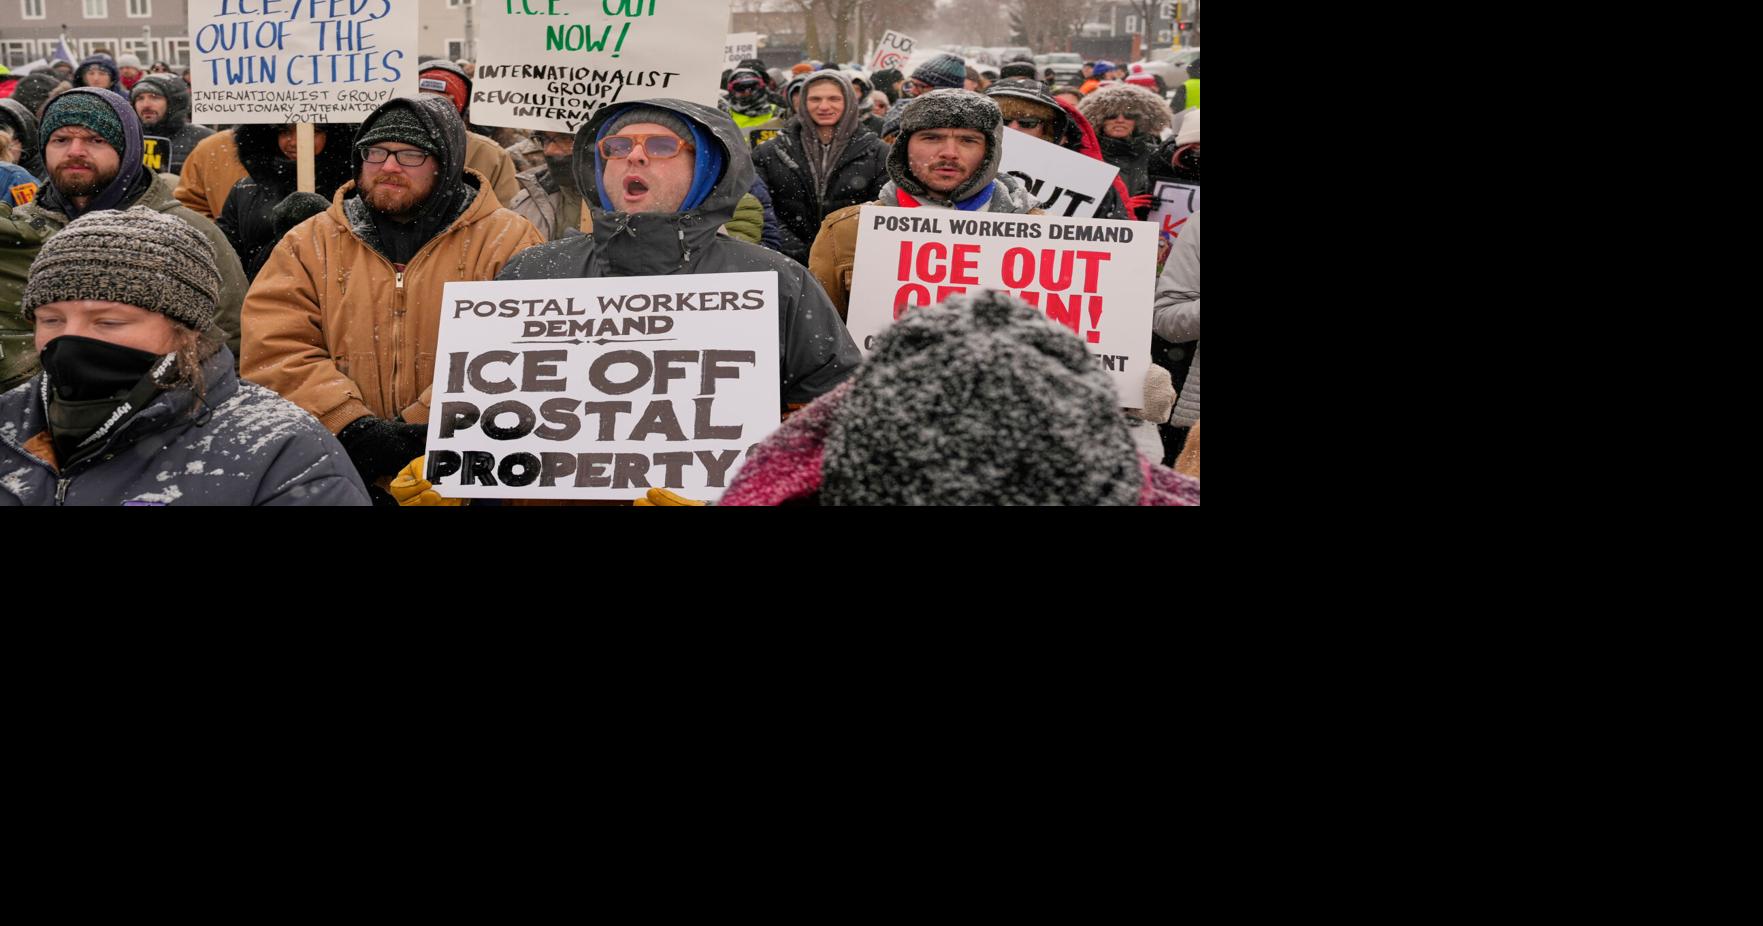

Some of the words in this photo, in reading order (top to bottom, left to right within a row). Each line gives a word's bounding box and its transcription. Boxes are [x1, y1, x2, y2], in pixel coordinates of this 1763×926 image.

[310, 19, 377, 51] THE
[546, 22, 631, 58] NOW!
[202, 55, 277, 86] TWIN
[287, 49, 404, 86] CITIES
[478, 64, 681, 88] INTERNATIONALIST
[193, 90, 330, 102] INTERNATIONALIST
[337, 87, 395, 102] GROUP/
[473, 90, 607, 110] REVOLUTION
[547, 81, 624, 103] GROUP/
[193, 103, 295, 113] REVOLUTIONARY
[300, 102, 381, 112] INTERNATIO
[284, 113, 329, 124] YOUTH
[873, 215, 942, 234] POSTAL
[949, 219, 1042, 239] WORKERS
[1049, 224, 1134, 243] DEMAND
[897, 240, 981, 285] ICE
[1001, 246, 1111, 294] OUT
[452, 297, 585, 319] POSTAL
[596, 289, 765, 314] WORKERS
[1002, 290, 1103, 344] N!
[521, 315, 674, 338] DEMAND
[444, 349, 568, 394] ICE
[588, 349, 756, 395] OFF
[438, 397, 744, 441] POSTAL
[427, 443, 760, 488] PROPERTY
